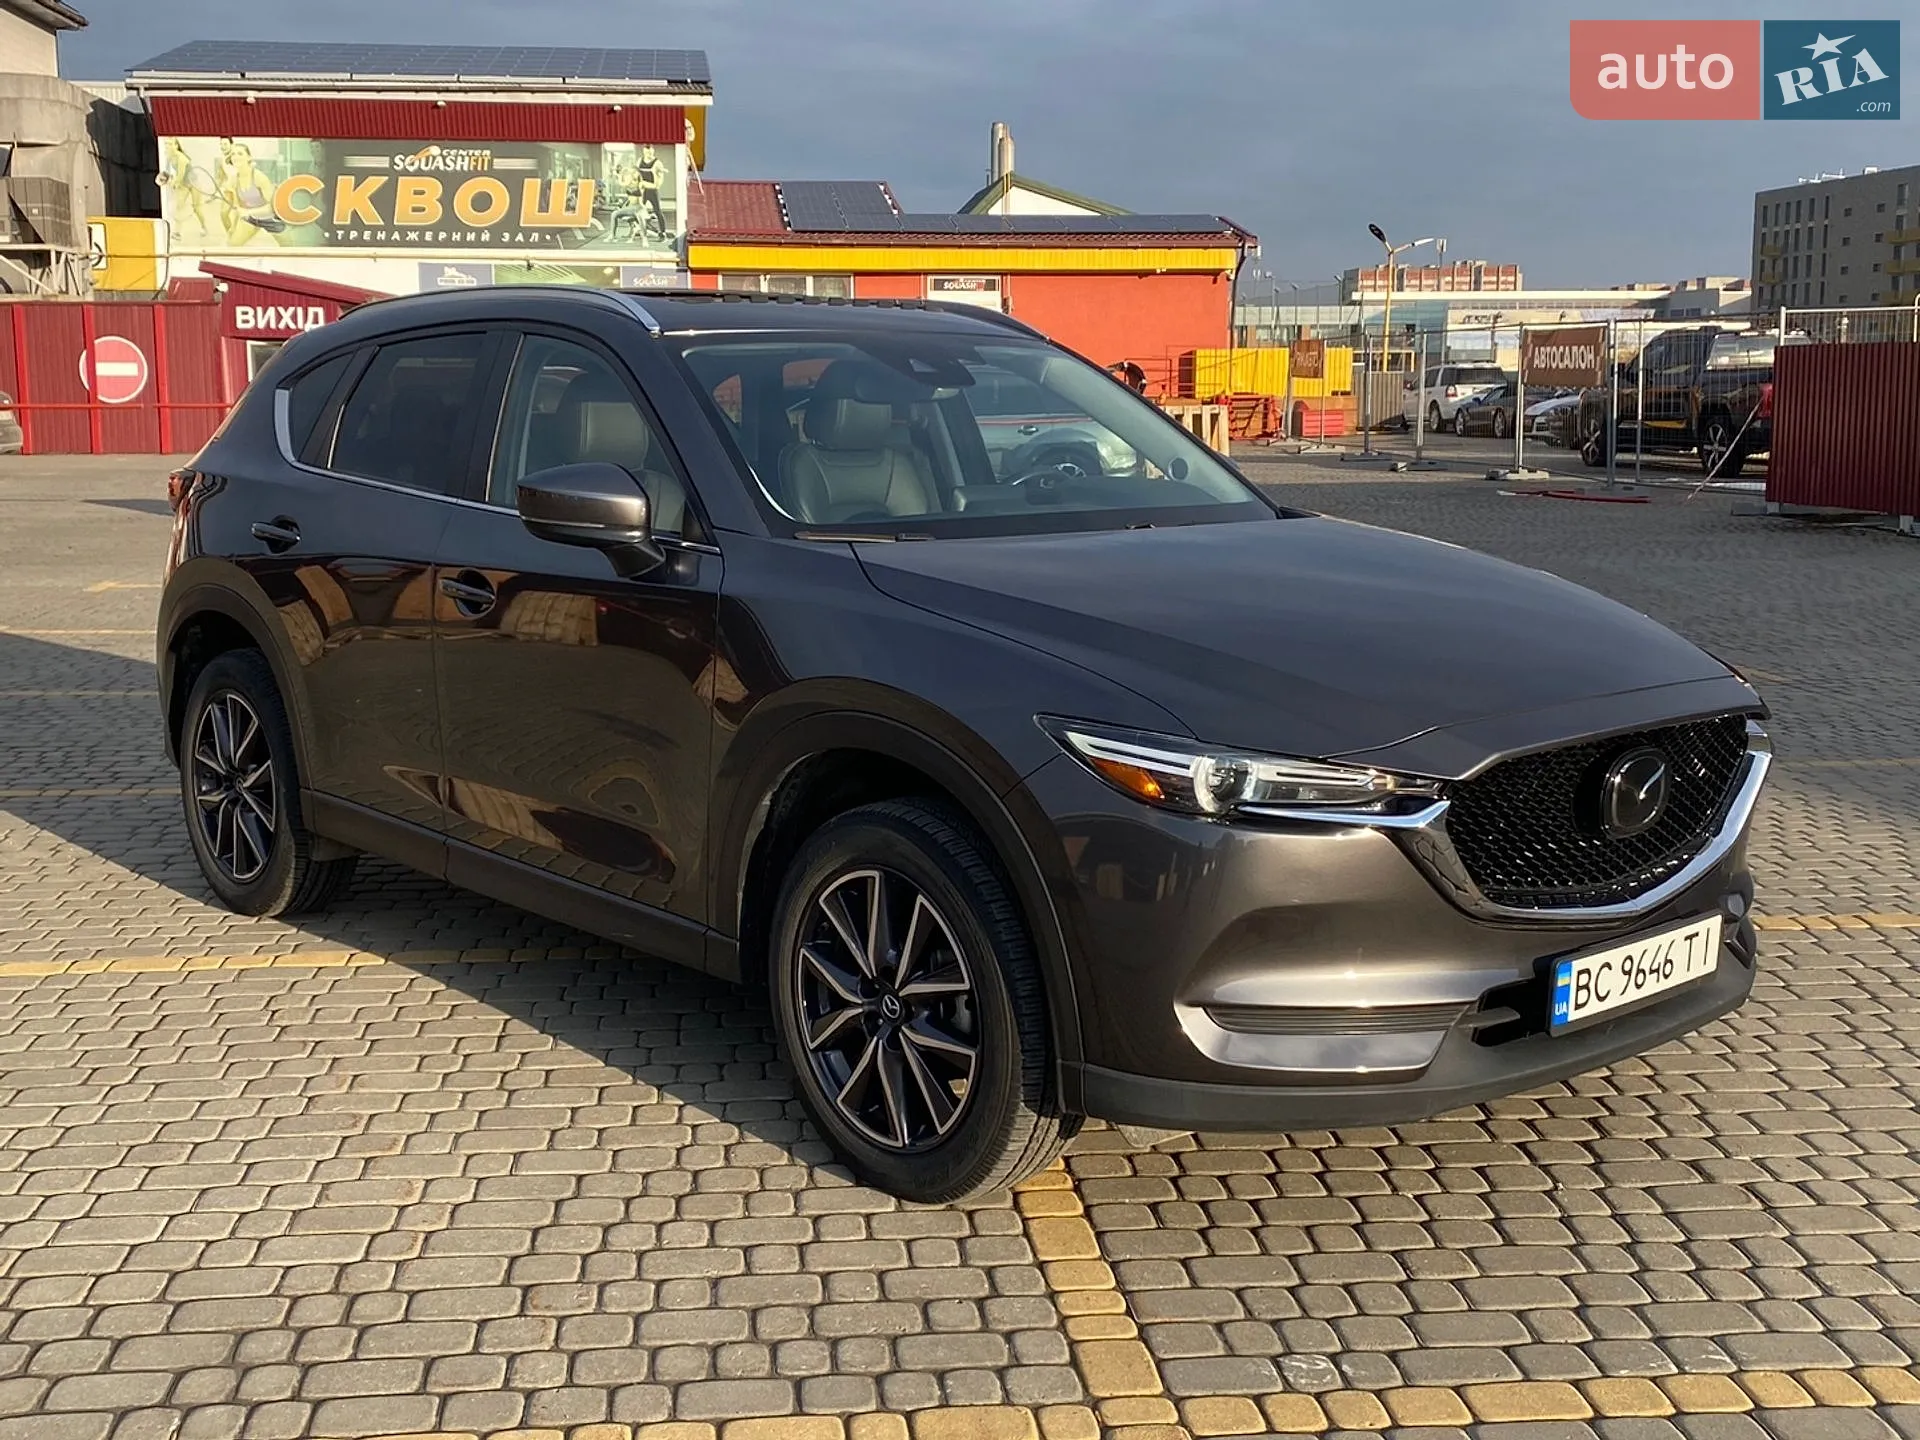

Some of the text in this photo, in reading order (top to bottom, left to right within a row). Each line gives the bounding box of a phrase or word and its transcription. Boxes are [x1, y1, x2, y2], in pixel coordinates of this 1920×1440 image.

[273, 174, 596, 228] СКВОШ
[336, 229, 540, 243] ТРЕНАЖЕРНИЙ ЗАЛ
[235, 305, 325, 332] ВИХІД
[1533, 344, 1595, 369] АВТОСАЛОН
[1574, 927, 1711, 1011] BC 9646 TI
[1554, 1003, 1568, 1016] UA
